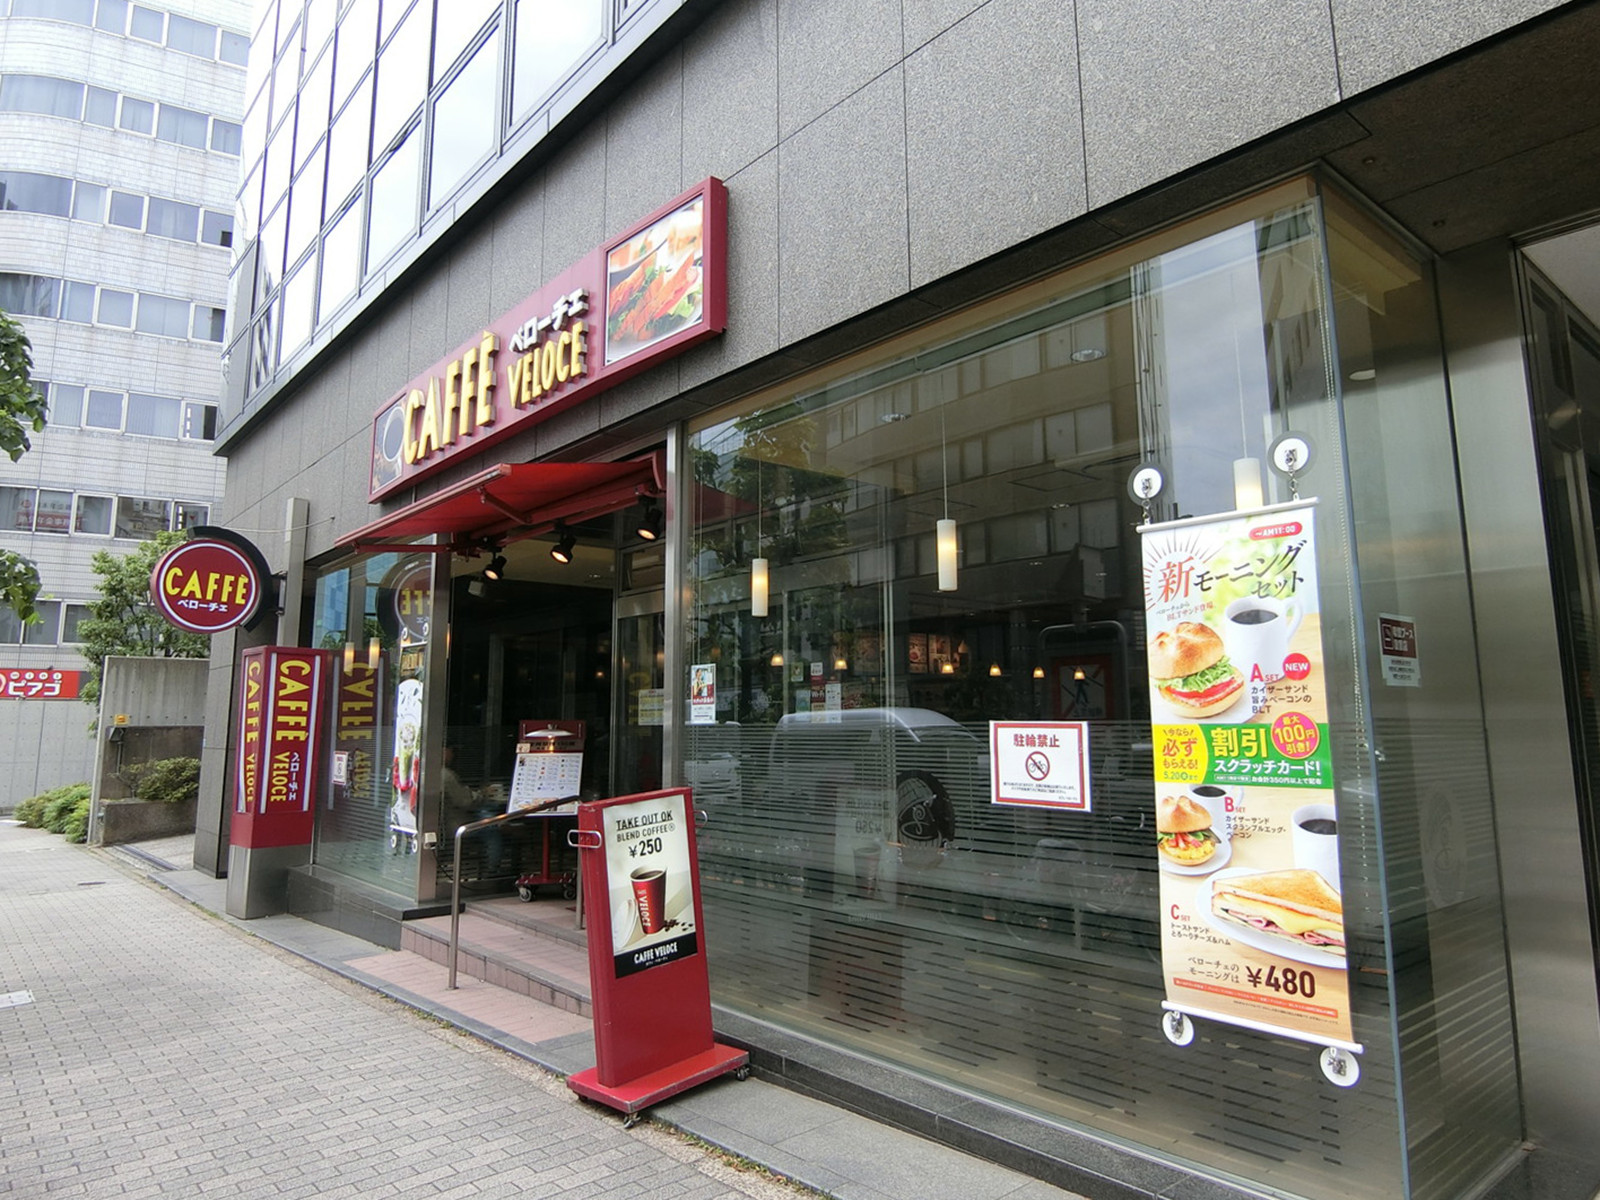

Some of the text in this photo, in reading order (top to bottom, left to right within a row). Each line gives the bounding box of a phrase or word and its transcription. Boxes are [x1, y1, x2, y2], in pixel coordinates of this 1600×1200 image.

[507, 320, 588, 409] VELOCE
[1158, 539, 1307, 603] 新 モーニング
[1251, 570, 1304, 600] セット
[1250, 663, 1280, 682] A SET
[1285, 662, 1308, 672] NEW
[8, 679, 62, 697] ピアゴ
[1251, 684, 1309, 694] カイザーサンド
[1252, 705, 1271, 714] BLT
[1013, 733, 1060, 748] 駐輪禁止
[1163, 737, 1198, 757] 必ず
[1210, 727, 1268, 758] 割引
[246, 753, 256, 802] VELOCE
[270, 751, 291, 802] VELOCE
[1224, 797, 1234, 812] B
[616, 810, 673, 831] TAKE OUT OK
[1225, 815, 1270, 825] カイザーサンド
[616, 830, 640, 843] BLEND
[628, 837, 663, 858] ¥250
[1171, 904, 1180, 920] C
[1171, 922, 1210, 934] トーストサンド
[654, 942, 678, 958] VELOCE
[1188, 956, 1240, 972] ベローチェの
[1188, 966, 1240, 984] モーニングは
[1245, 965, 1316, 998] ¥480
